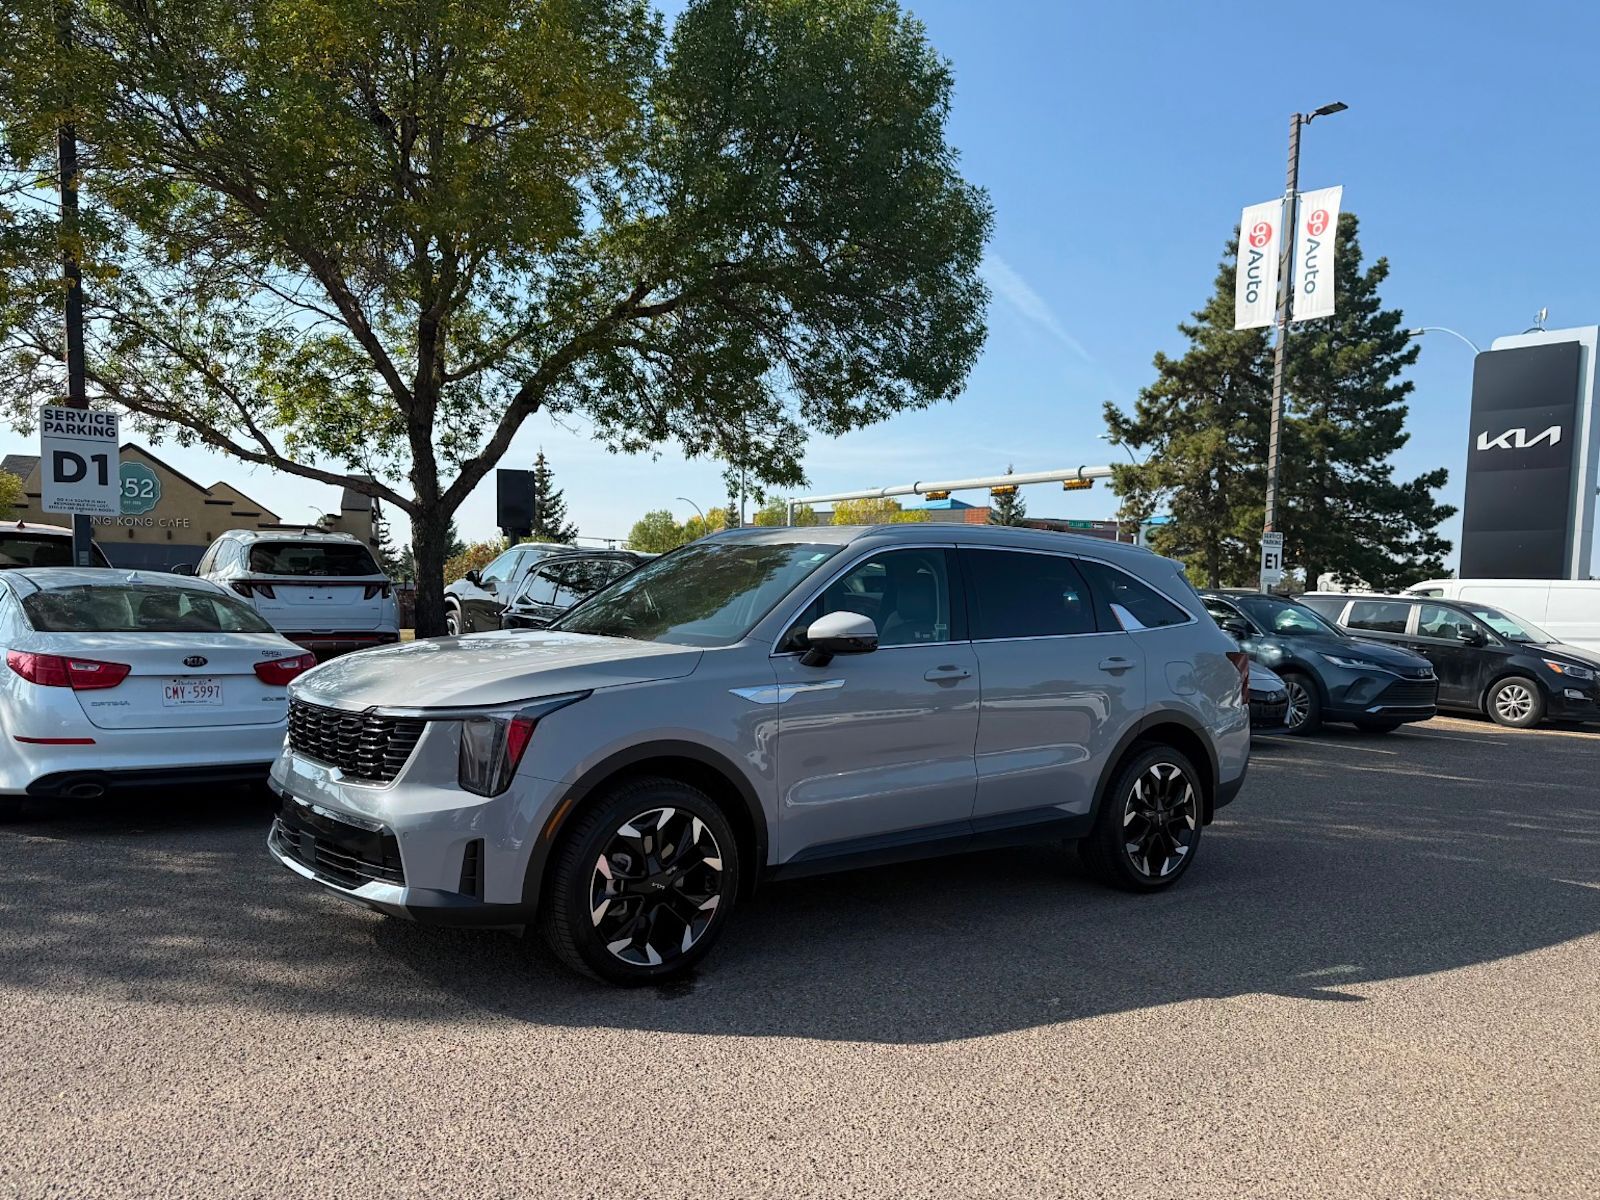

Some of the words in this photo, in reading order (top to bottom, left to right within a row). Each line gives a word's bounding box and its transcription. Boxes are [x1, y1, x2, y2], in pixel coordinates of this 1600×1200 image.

[1304, 238, 1321, 294] Auto
[1245, 249, 1264, 304] Auto
[44, 409, 116, 426] SERVICE
[44, 422, 116, 438] PARKING
[1476, 425, 1562, 451] KIA
[53, 450, 109, 486] D1
[120, 478, 154, 498] 52
[116, 516, 153, 527] KONG
[158, 518, 190, 528] CAFE
[1265, 553, 1279, 569] E1
[185, 657, 206, 666] KIA
